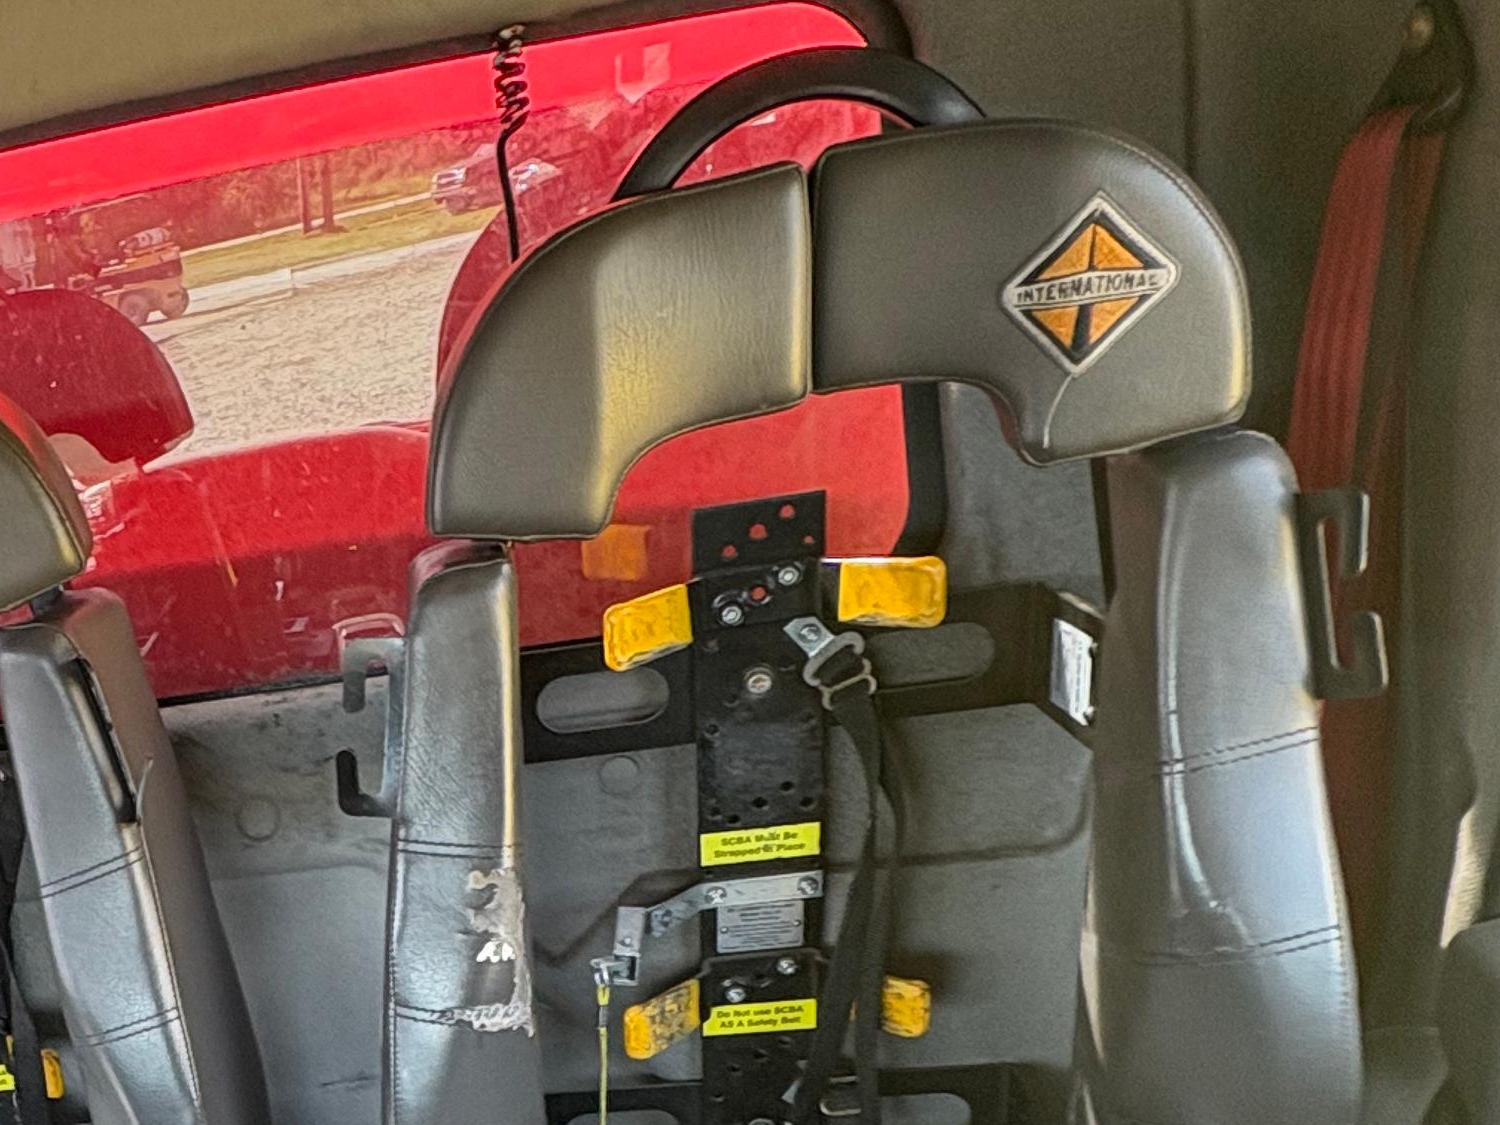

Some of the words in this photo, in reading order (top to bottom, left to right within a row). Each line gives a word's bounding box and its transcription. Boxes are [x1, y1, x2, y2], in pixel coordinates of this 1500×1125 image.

[1017, 272, 1158, 302] INTERNATIONAL
[721, 837, 751, 846] SCBA
[783, 832, 797, 840] Be
[717, 1010, 731, 1018] Do
[733, 1009, 751, 1017] Not
[774, 1006, 804, 1014] SCBA
[747, 1018, 778, 1028] Safety
